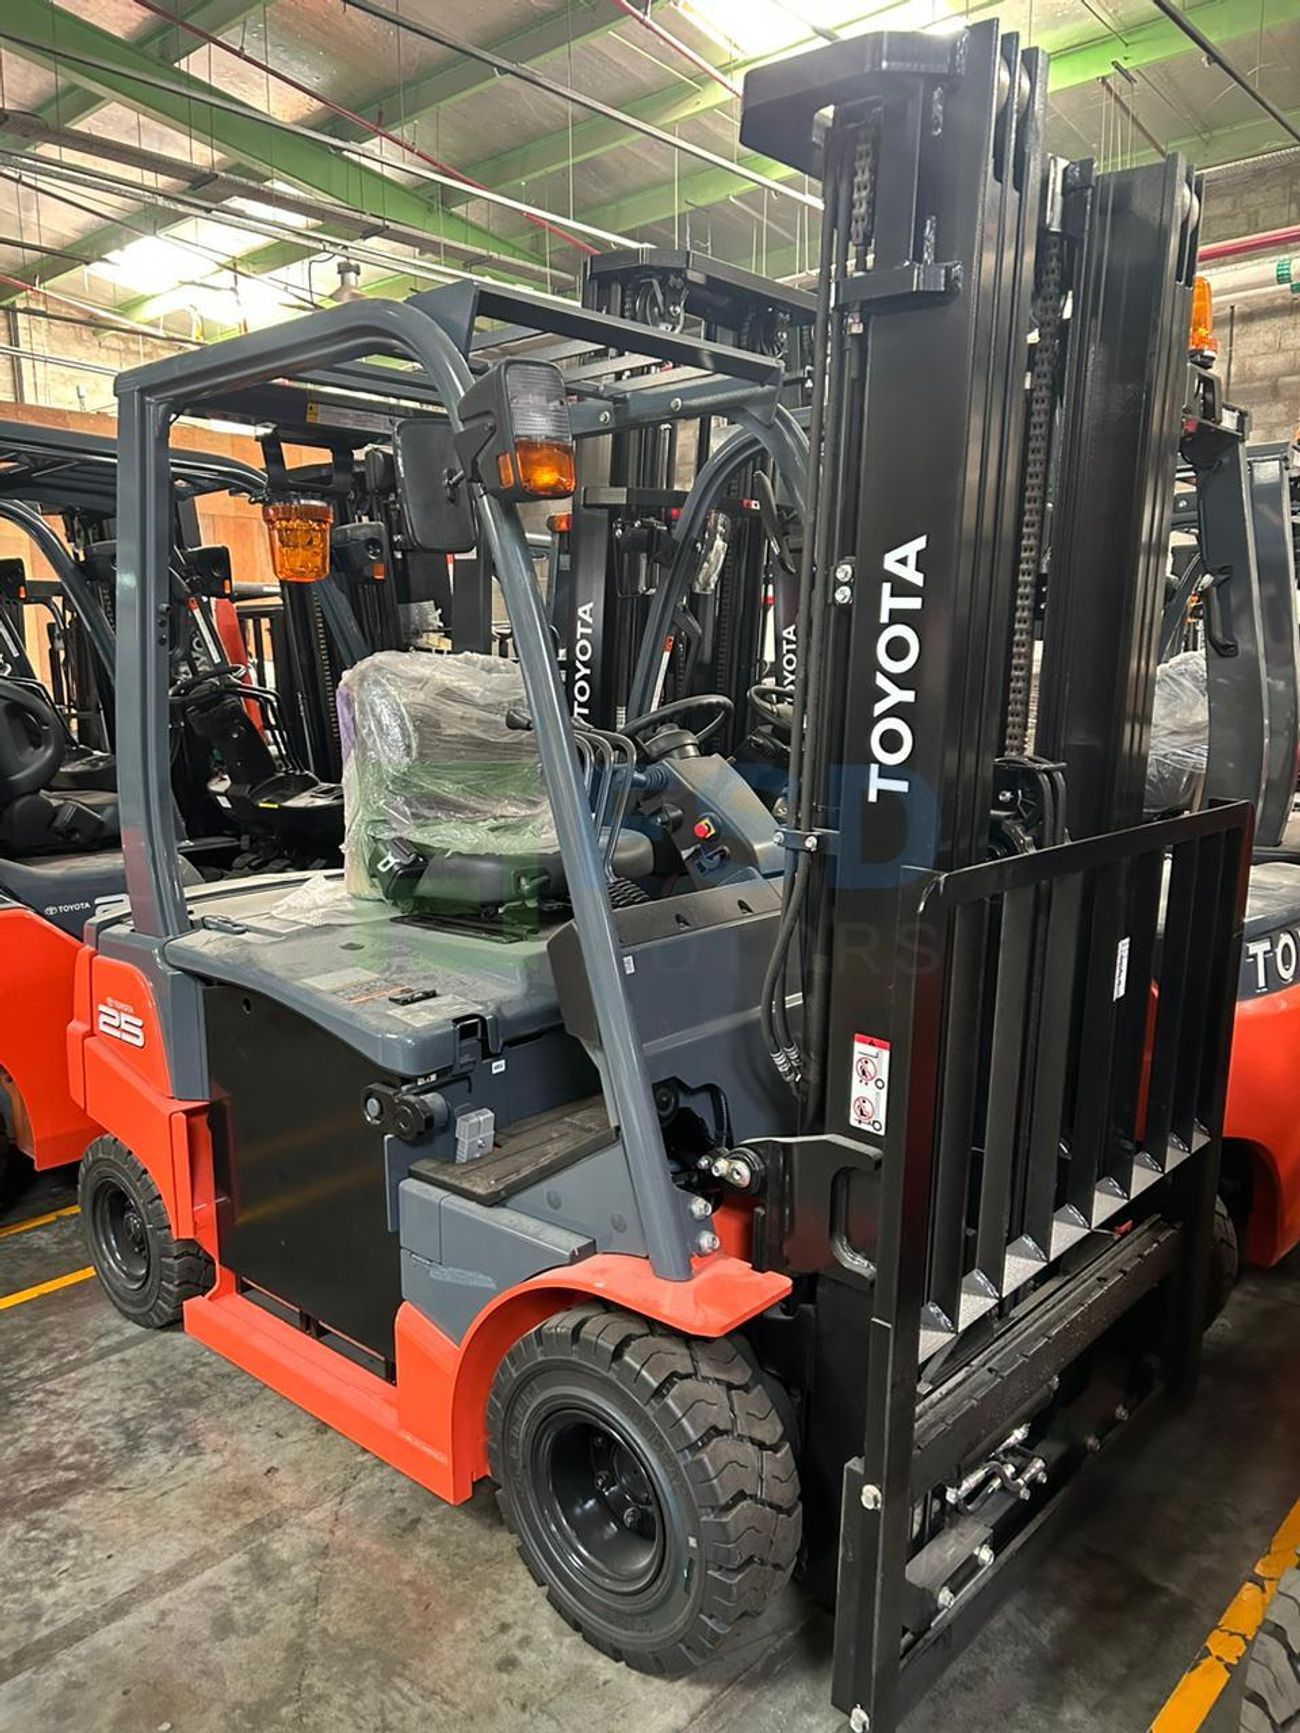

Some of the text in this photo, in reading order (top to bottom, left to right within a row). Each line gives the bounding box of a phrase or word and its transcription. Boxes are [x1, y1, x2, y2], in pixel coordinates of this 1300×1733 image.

[573, 601, 595, 718] TOYOTA
[782, 623, 798, 705] YOTA
[868, 534, 928, 802] TOYOTA
[58, 902, 92, 913] TOYOTA
[1245, 927, 1300, 990] TO
[97, 1003, 146, 1048] 25
